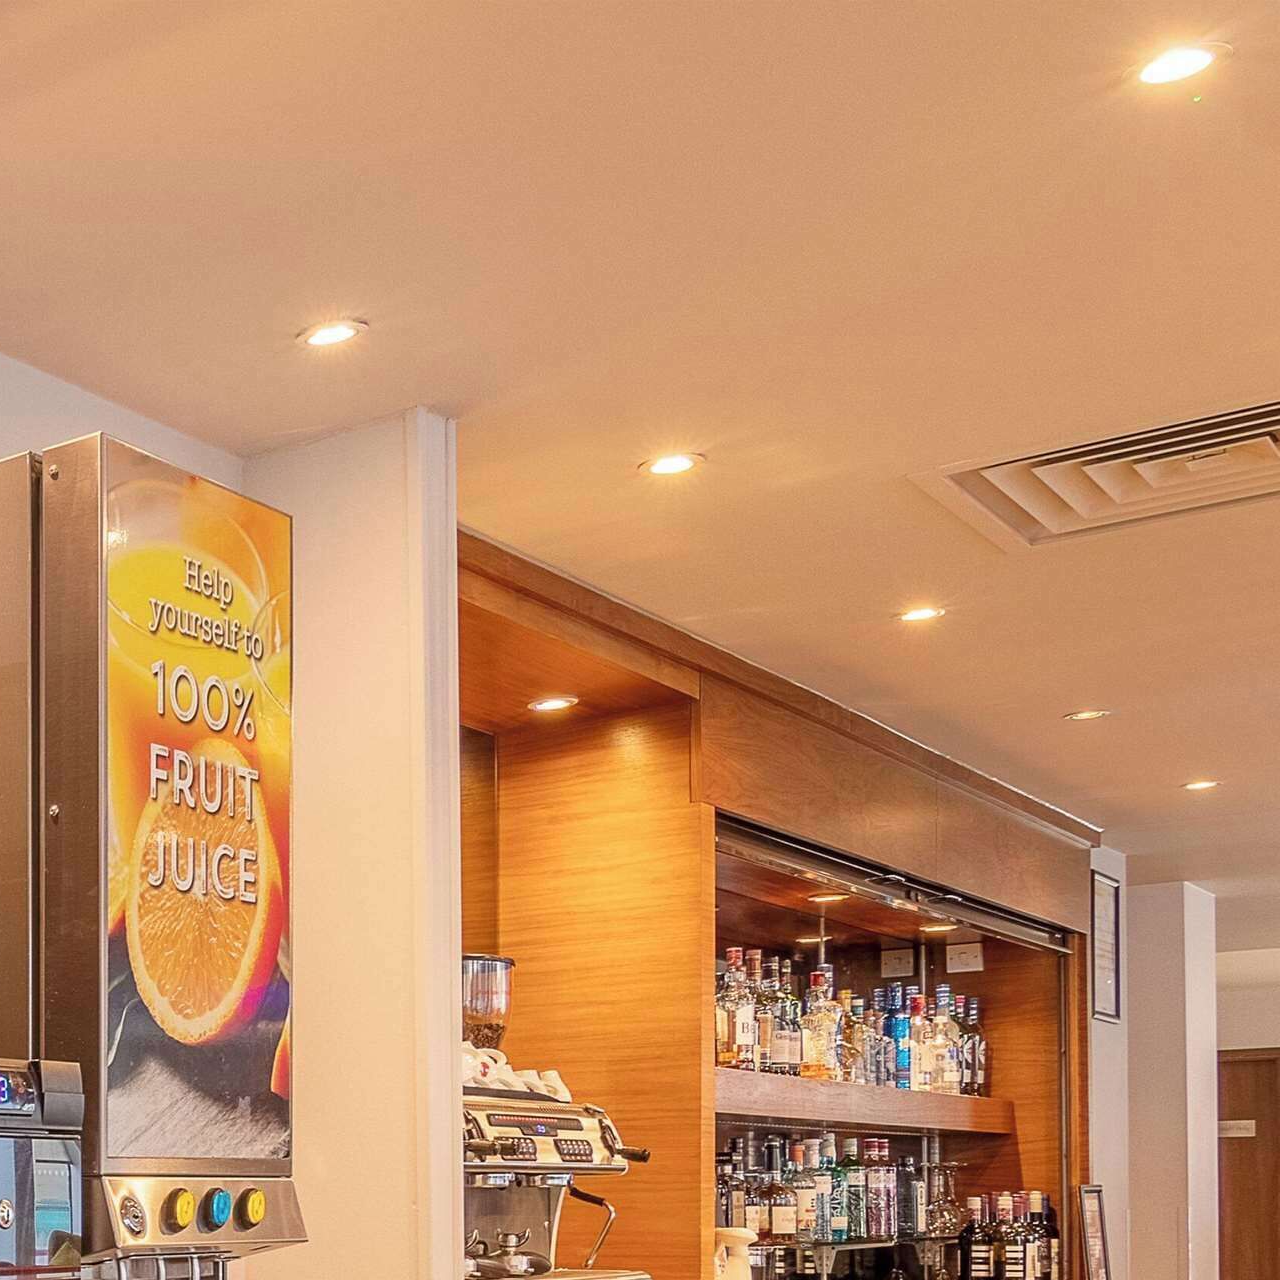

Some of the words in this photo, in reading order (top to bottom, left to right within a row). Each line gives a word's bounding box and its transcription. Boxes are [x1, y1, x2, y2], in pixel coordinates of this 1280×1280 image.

[183, 556, 234, 611] Help
[148, 598, 241, 653] yourself
[243, 624, 264, 660] to
[151, 659, 256, 741] 100%
[149, 742, 260, 822] FRUIT
[147, 831, 258, 904] JUICE
